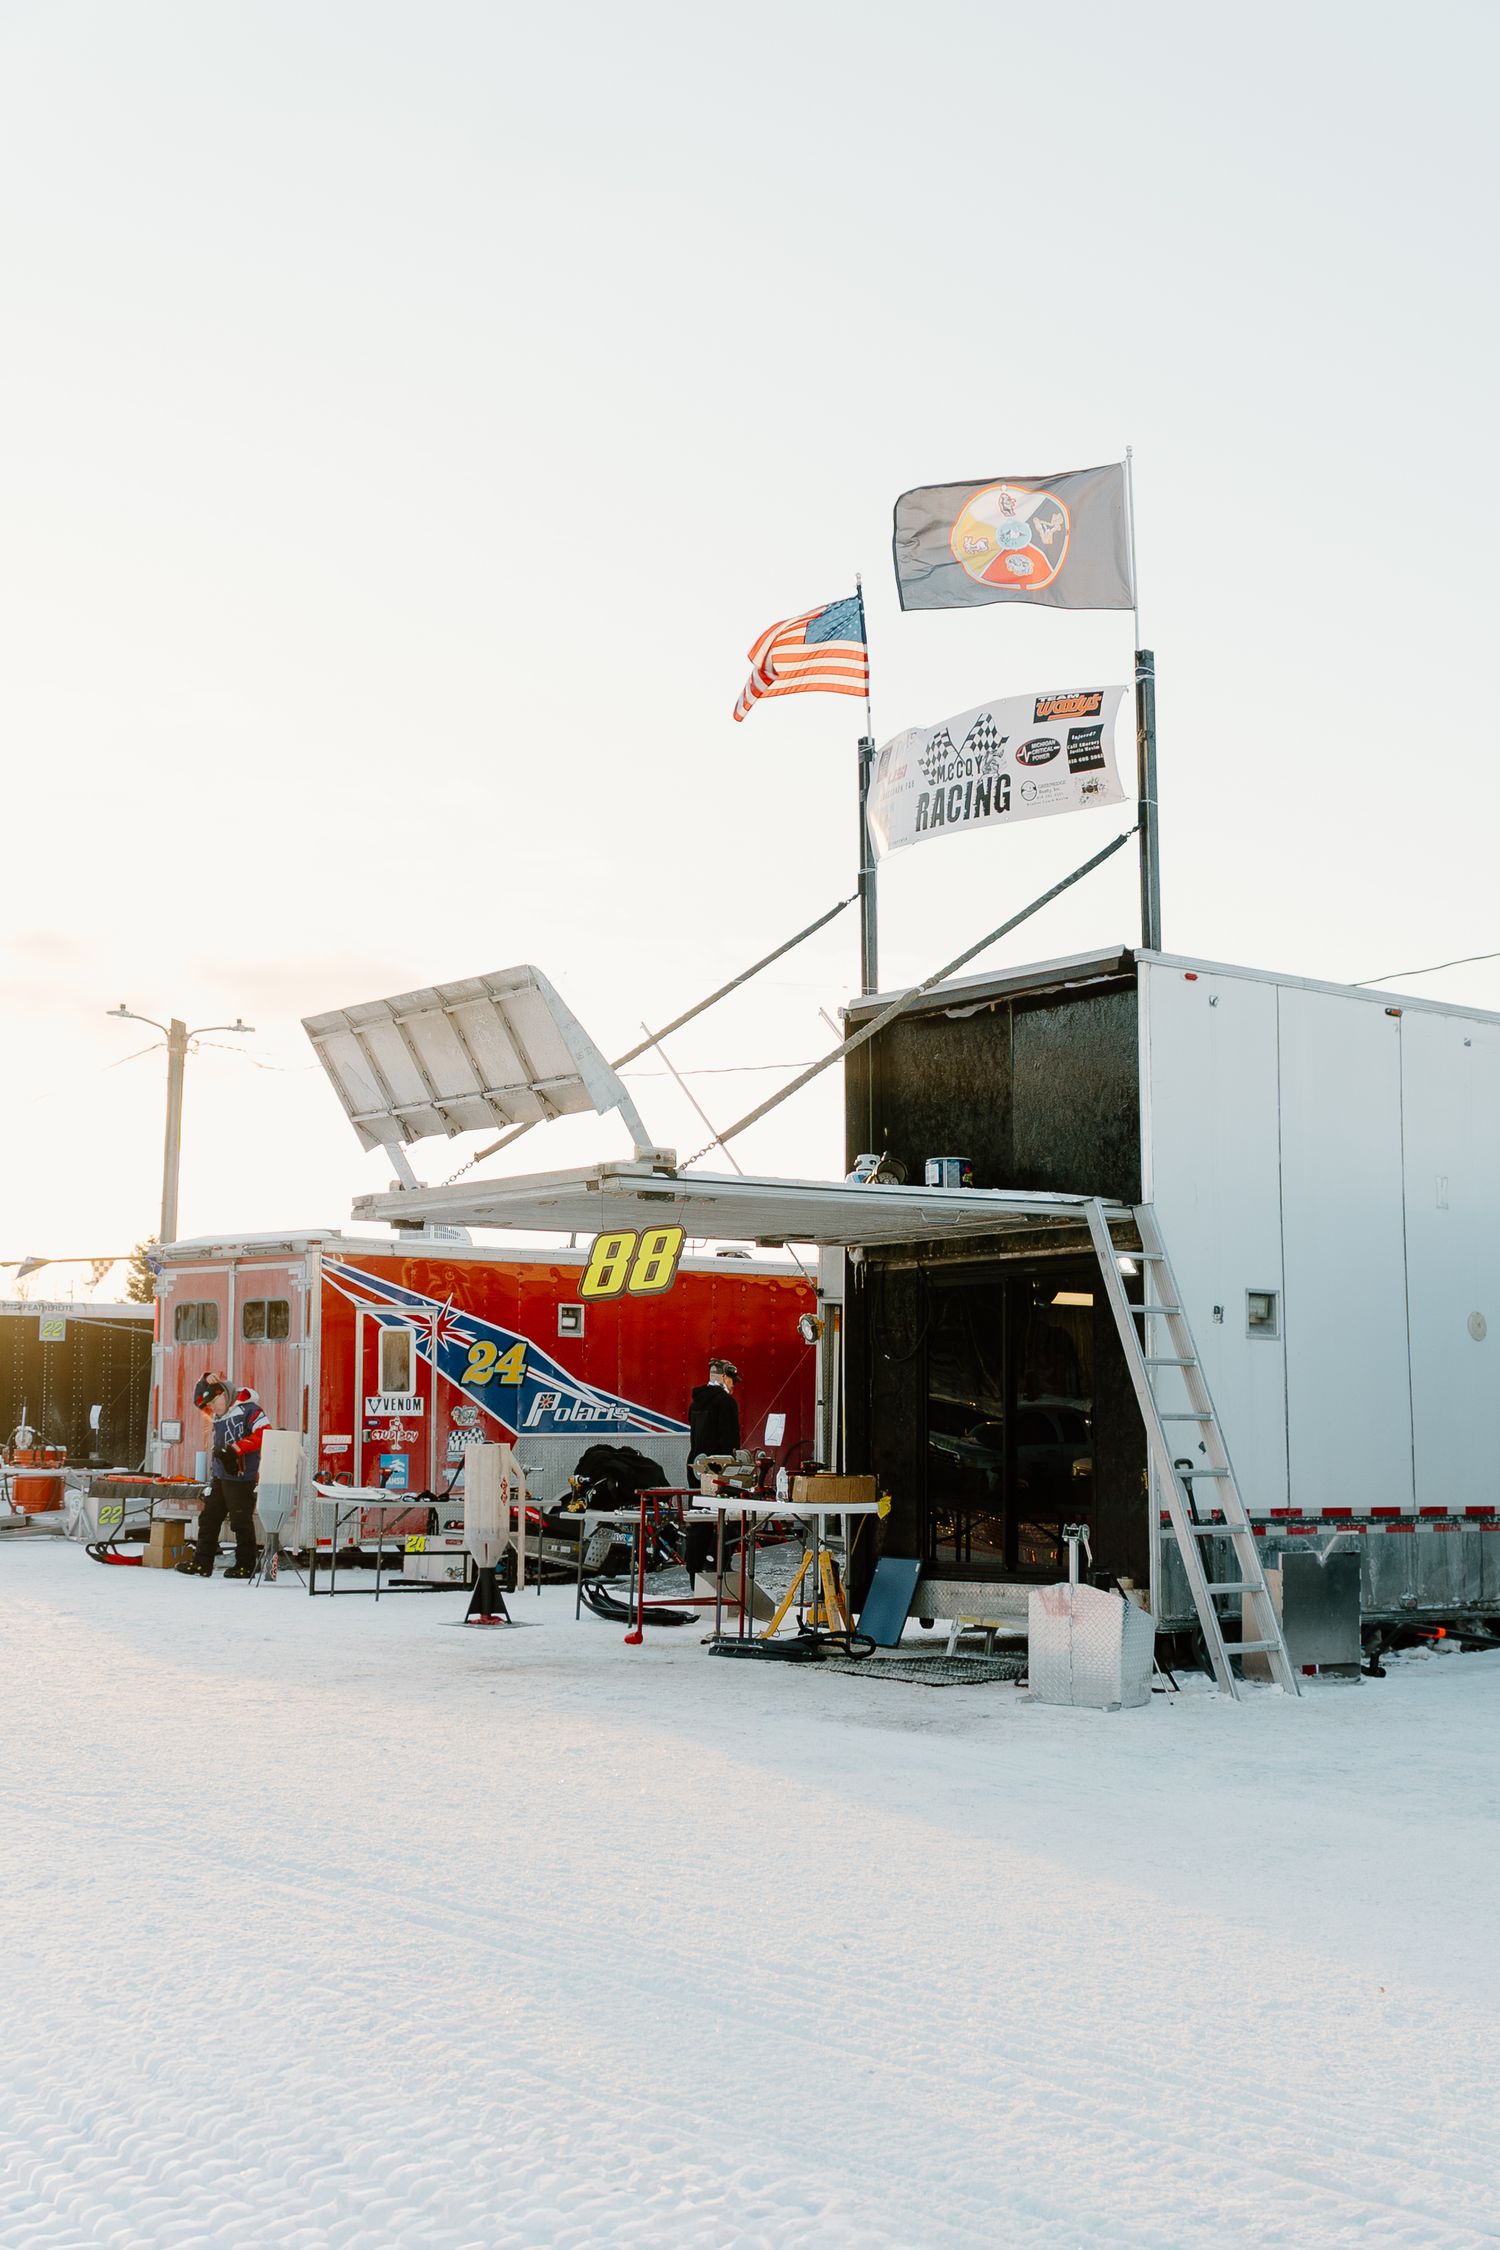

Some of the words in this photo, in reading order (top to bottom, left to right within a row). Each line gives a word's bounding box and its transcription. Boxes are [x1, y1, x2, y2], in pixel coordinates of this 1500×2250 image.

[1031, 740, 1056, 749] MICHIGAN
[1031, 746, 1054, 755] CRITICAL
[1032, 753, 1050, 761] POWER
[915, 773, 1011, 832] RACING
[579, 1225, 685, 1299] 88
[42, 1320, 65, 1337] 22
[460, 1340, 528, 1385] 24
[383, 1398, 421, 1411] VENOM
[521, 1391, 630, 1427] Polaris
[372, 1430, 395, 1441] STUD
[98, 1505, 123, 1525] 22
[404, 1535, 427, 1553] 24
